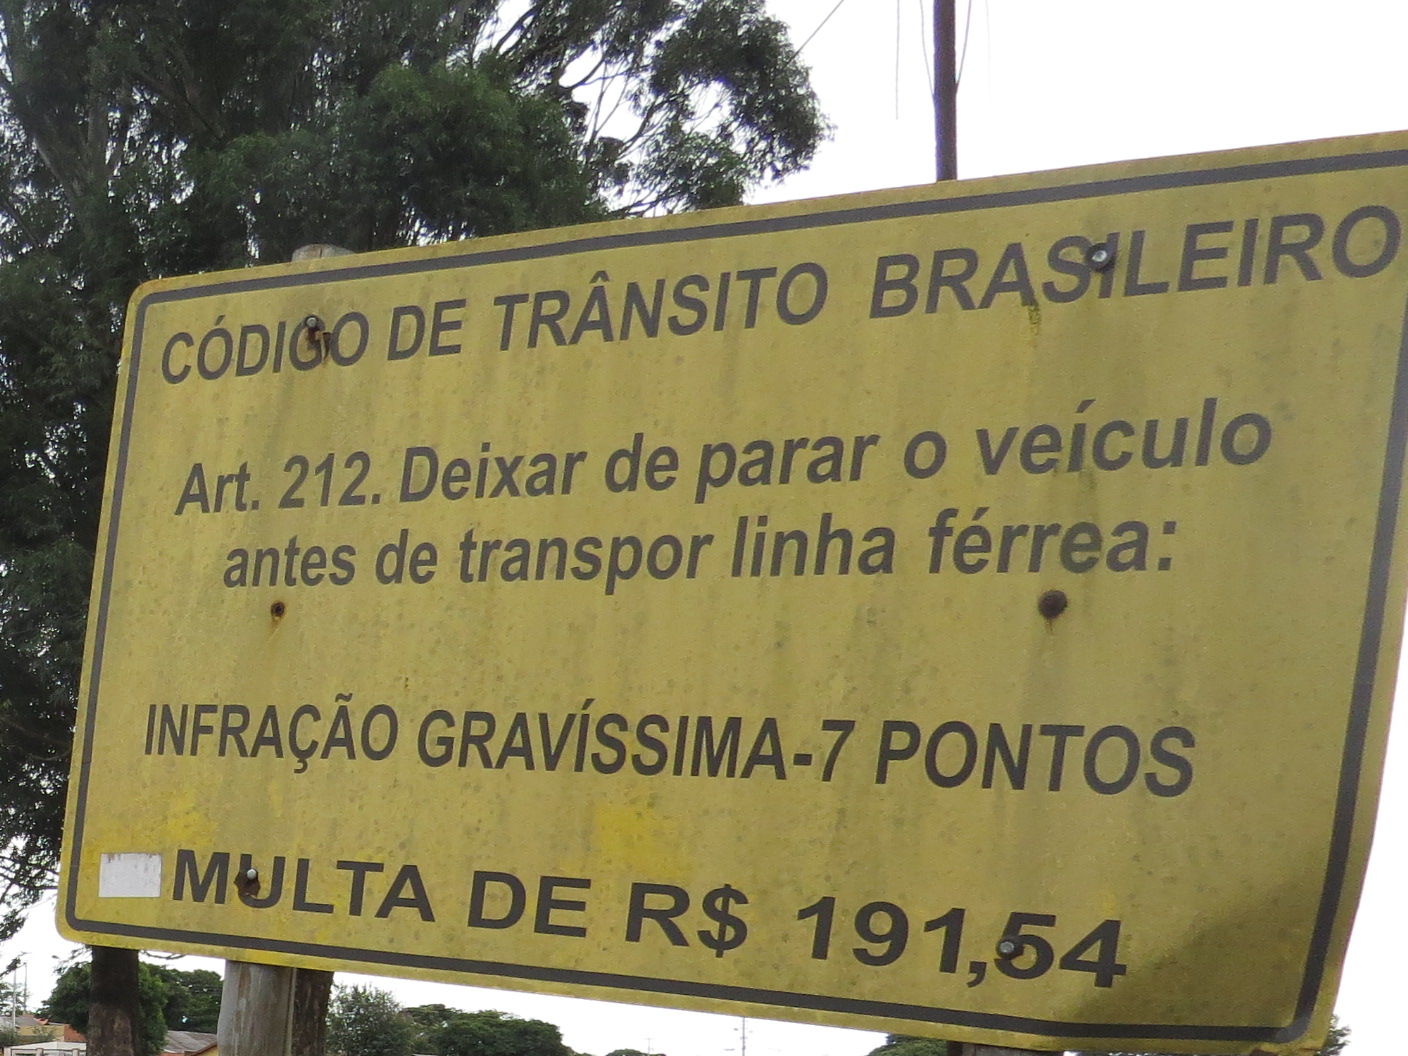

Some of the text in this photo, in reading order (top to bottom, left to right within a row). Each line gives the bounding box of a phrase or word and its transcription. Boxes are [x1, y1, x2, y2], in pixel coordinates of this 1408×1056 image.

[161, 205, 1401, 385] CÓDIGO DE TRÂNSITO BRASILEIRO
[175, 397, 1272, 515] Art. 212. Deixar de parar o veículo
[223, 507, 1177, 596] antes de transpor linha férrea:
[144, 693, 398, 774] INFRAÇÃO
[874, 719, 1196, 798] PONTOS
[172, 849, 1127, 988] MULTA DE R$ 191,54
